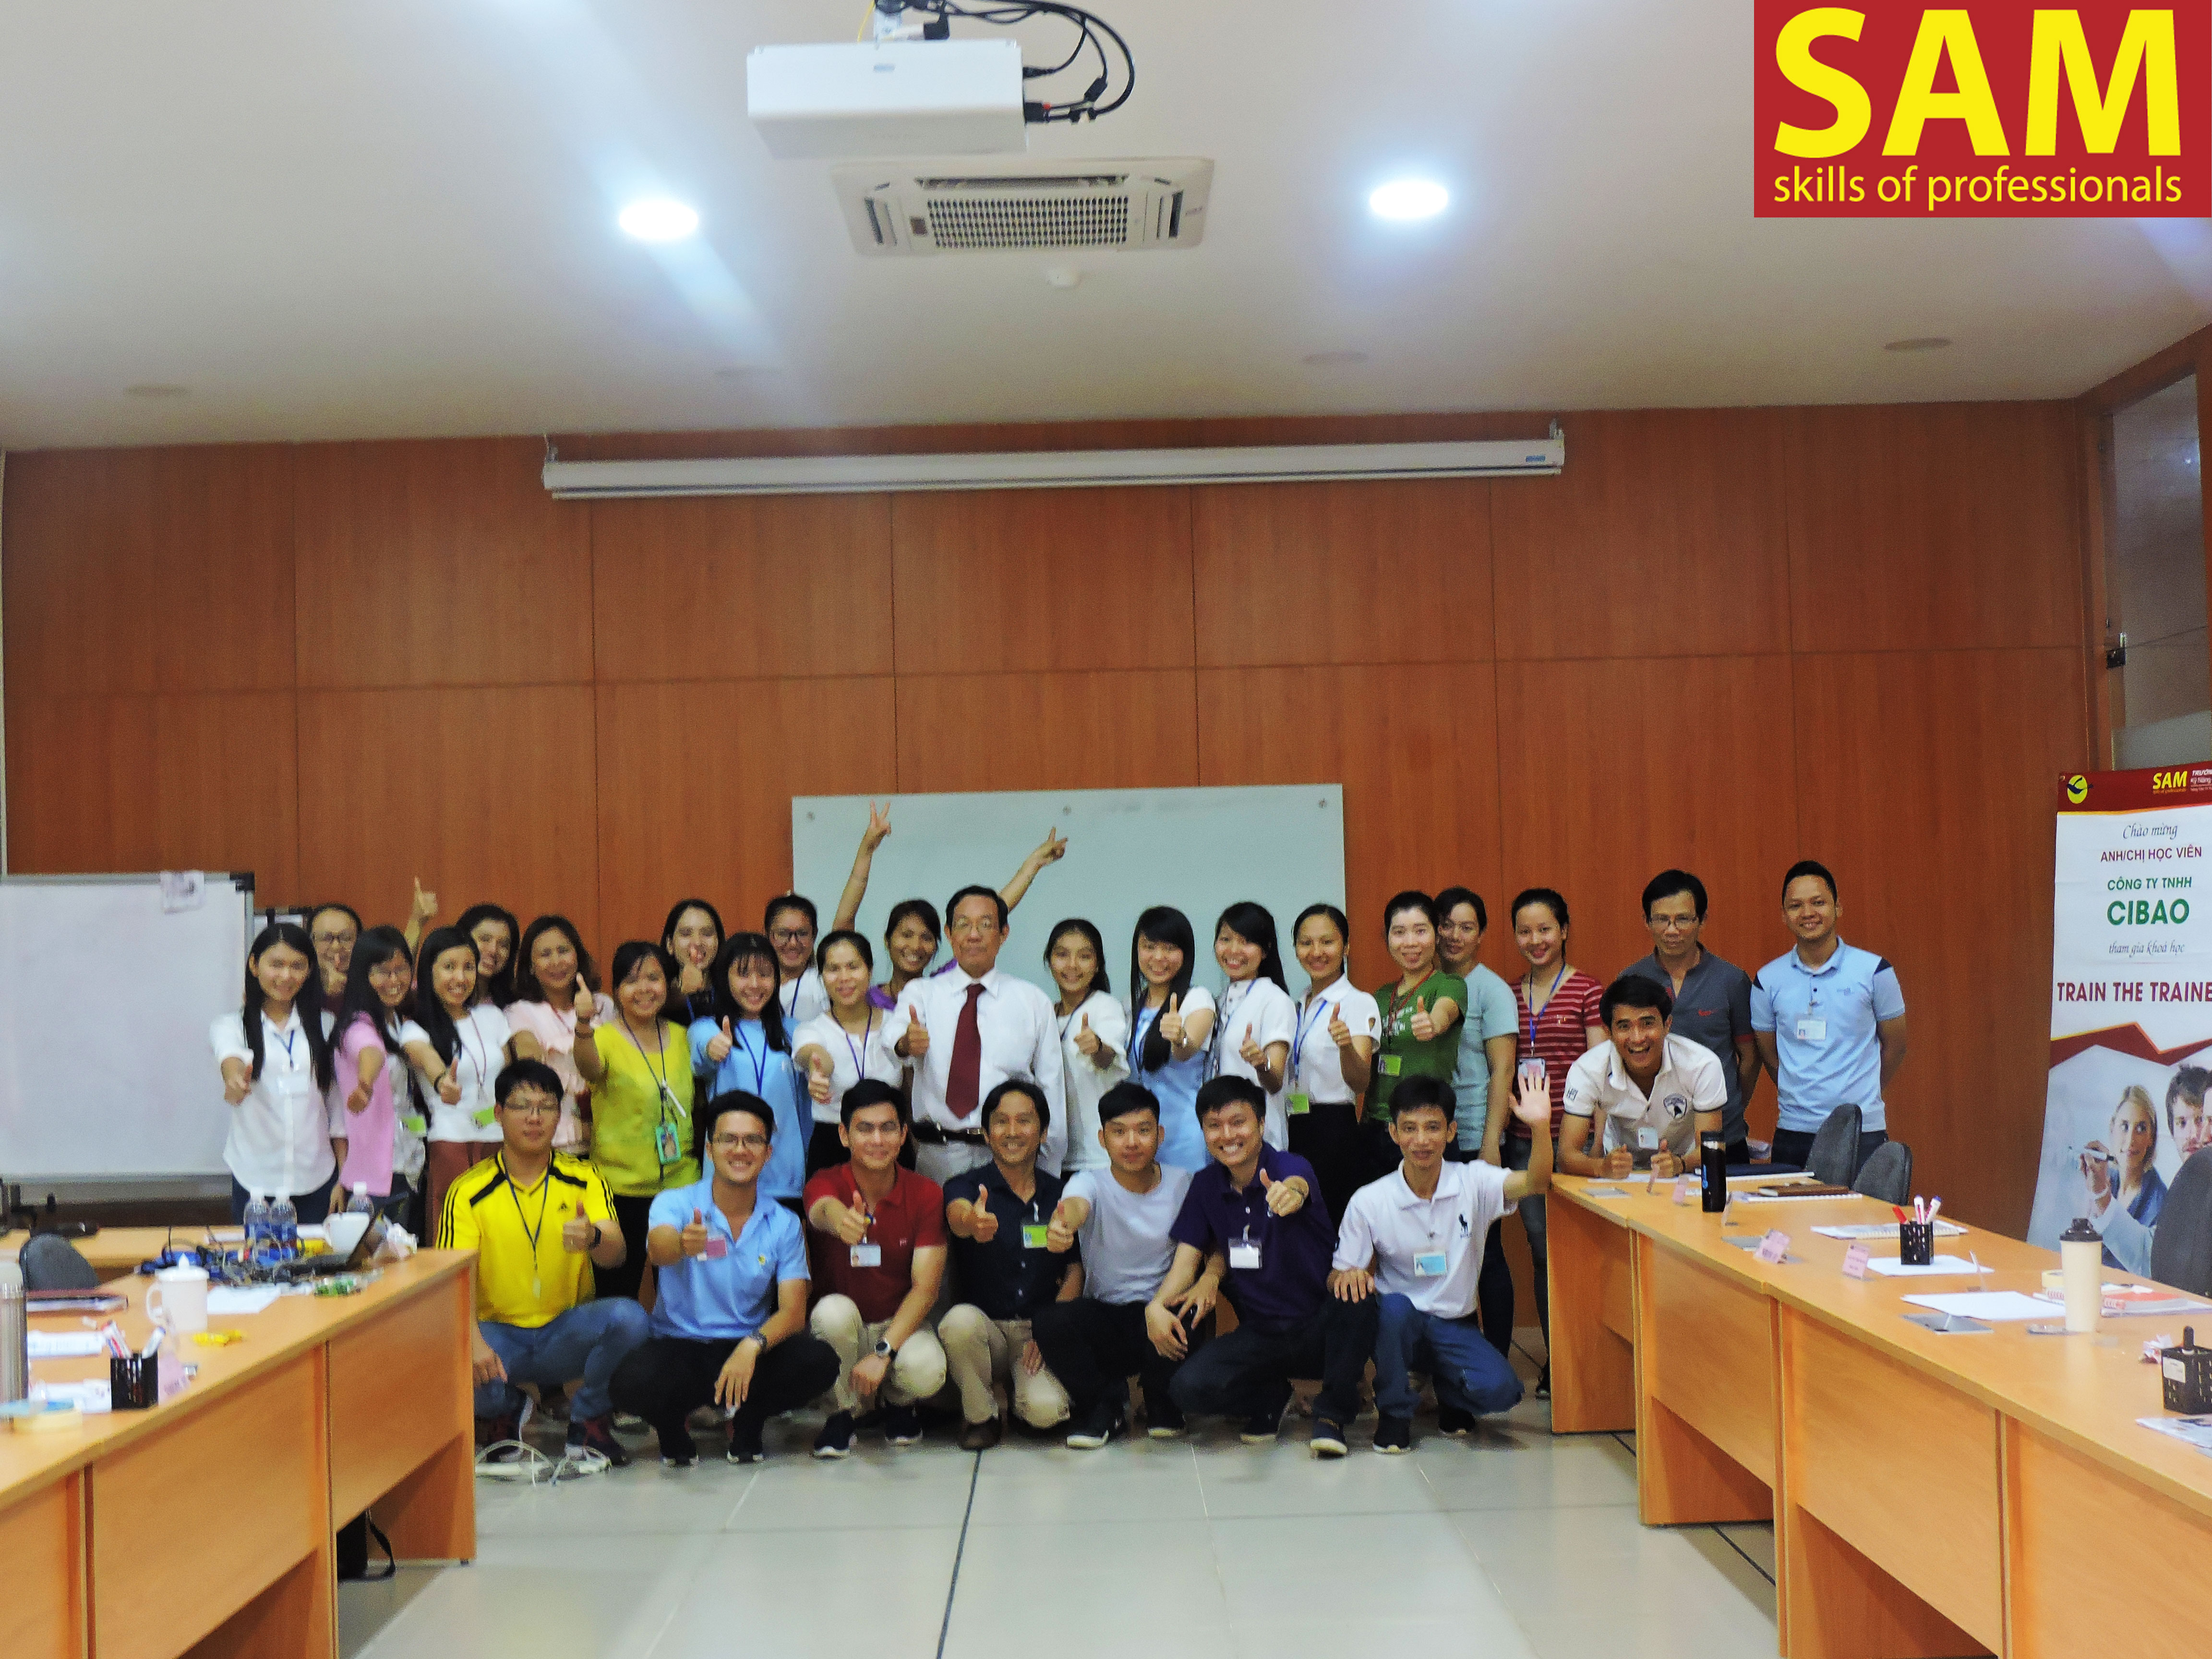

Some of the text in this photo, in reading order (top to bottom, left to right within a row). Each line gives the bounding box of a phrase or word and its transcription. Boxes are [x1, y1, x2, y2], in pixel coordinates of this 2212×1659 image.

[2153, 771, 2187, 790] SAM
[2123, 823, 2177, 840] Chào mừng
[2101, 844, 2201, 863] ANH/CHỊ HỌC VIÊN
[2107, 876, 2192, 890] CÔNG TY TNHH
[2107, 898, 2189, 926] CIBAO
[2109, 941, 2129, 954] tham
[2129, 942, 2144, 958] gia
[2170, 939, 2185, 955] học
[2057, 982, 2212, 1002] TRAIN THE TRAINE
